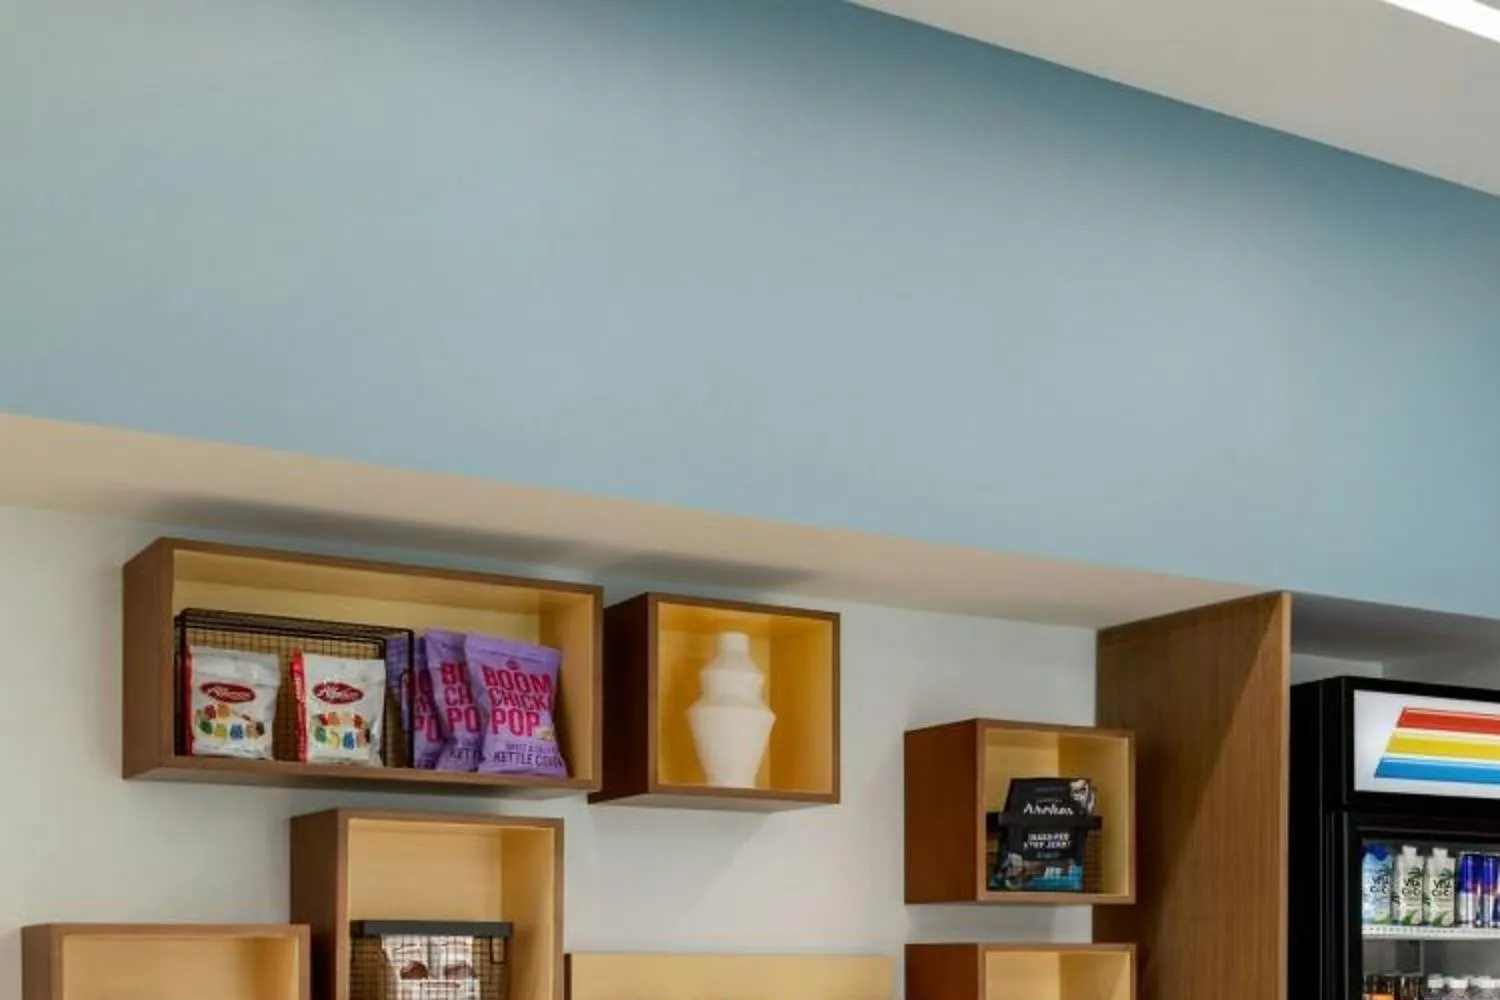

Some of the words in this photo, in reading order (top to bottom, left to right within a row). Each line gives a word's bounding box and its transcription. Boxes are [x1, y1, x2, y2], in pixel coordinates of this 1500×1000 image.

[482, 665, 553, 694] BOOM
[446, 706, 482, 733] PO
[491, 708, 541, 737] POP
